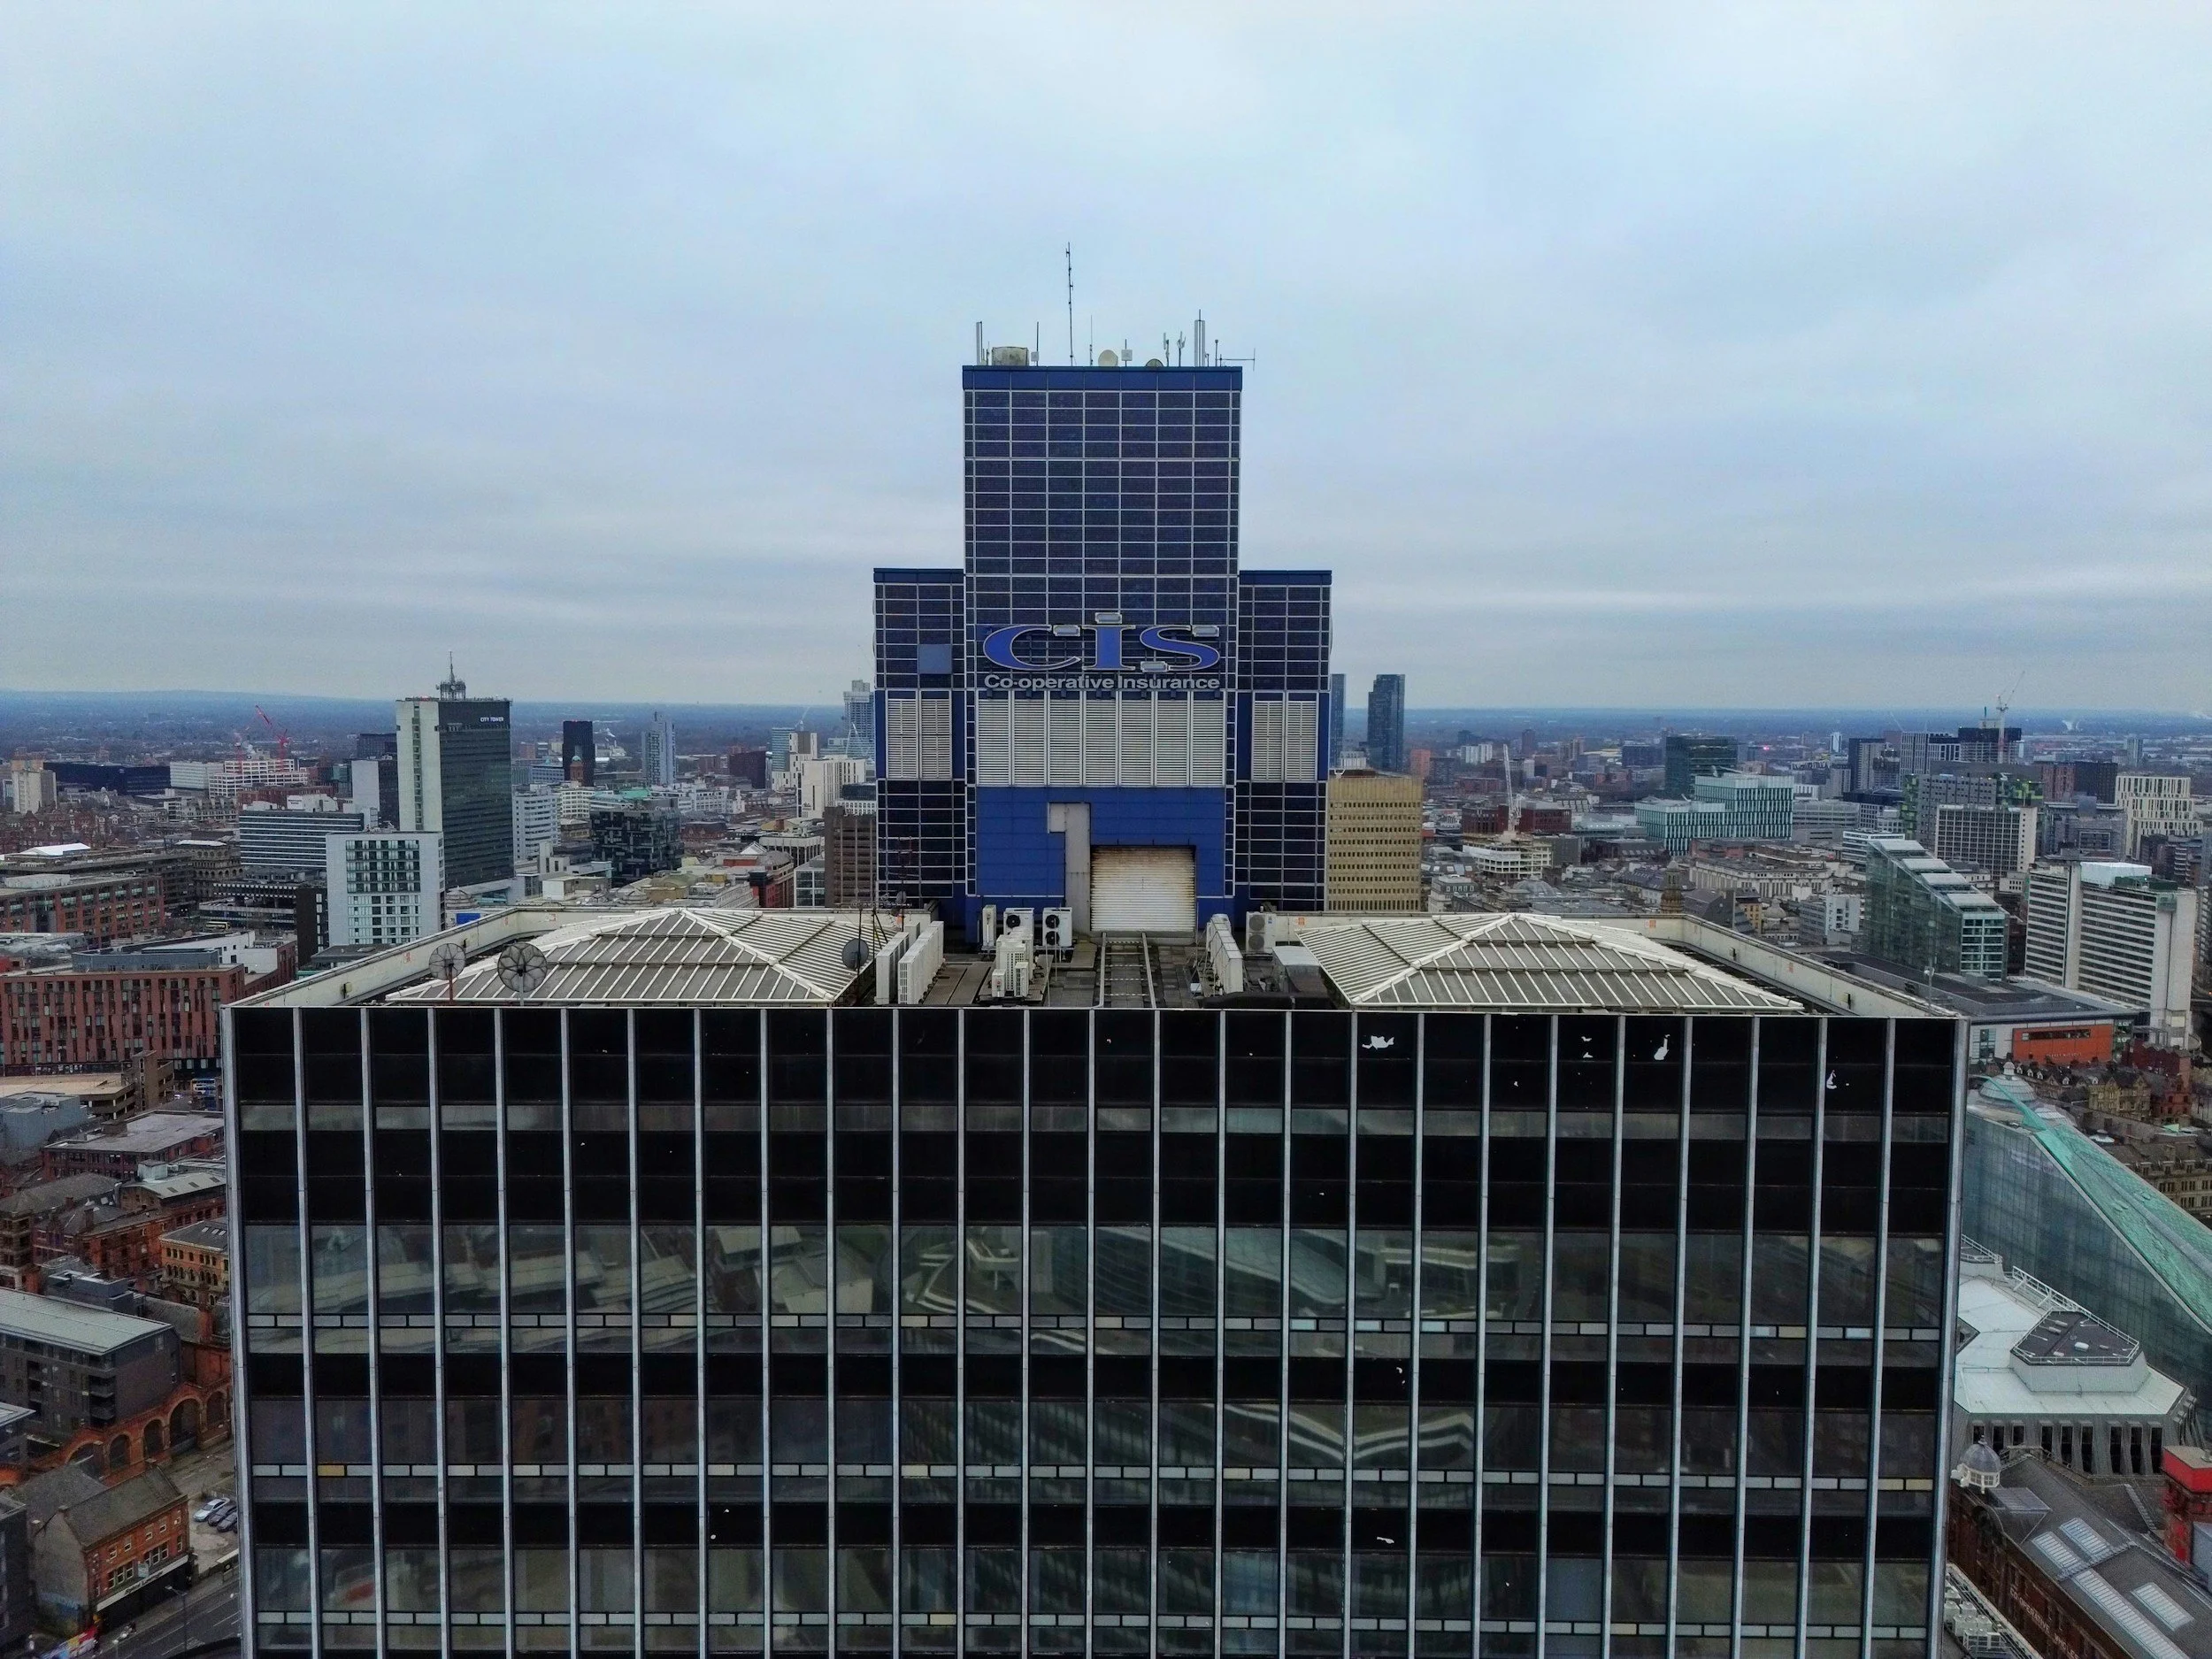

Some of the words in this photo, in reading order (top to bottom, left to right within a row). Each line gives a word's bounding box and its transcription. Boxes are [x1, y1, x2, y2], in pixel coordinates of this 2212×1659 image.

[983, 612, 1220, 671] CIS
[984, 674, 1115, 691] Co-operative
[1118, 675, 1220, 689] Insurance
